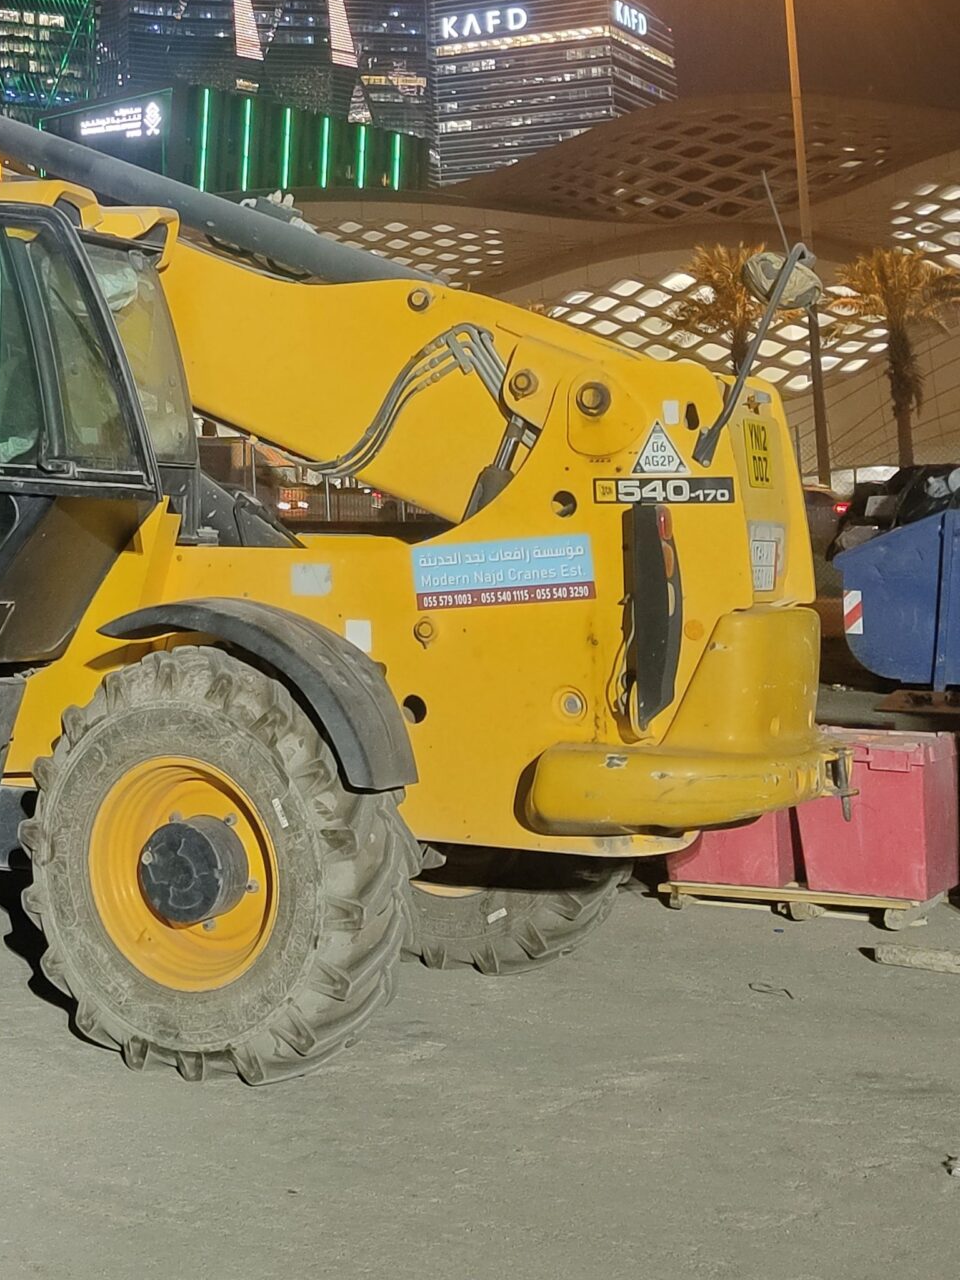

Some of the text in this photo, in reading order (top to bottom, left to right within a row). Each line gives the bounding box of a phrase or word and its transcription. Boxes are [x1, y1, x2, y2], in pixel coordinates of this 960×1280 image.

[442, 7, 528, 39] KAFD
[614, 0, 648, 36] KAFD
[644, 455, 675, 467] AG2P
[418, 543, 584, 567] مؤسسة رافعات نجد الحديثة
[421, 563, 587, 588] Modern Najd Cranes Est.
[423, 595, 438, 608] 055
[439, 594, 453, 607] 579
[454, 593, 472, 605] 1003
[480, 592, 496, 604] 055
[497, 590, 512, 603] 540
[513, 589, 530, 601] 1115
[535, 587, 552, 600] 055
[552, 586, 568, 599] 540
